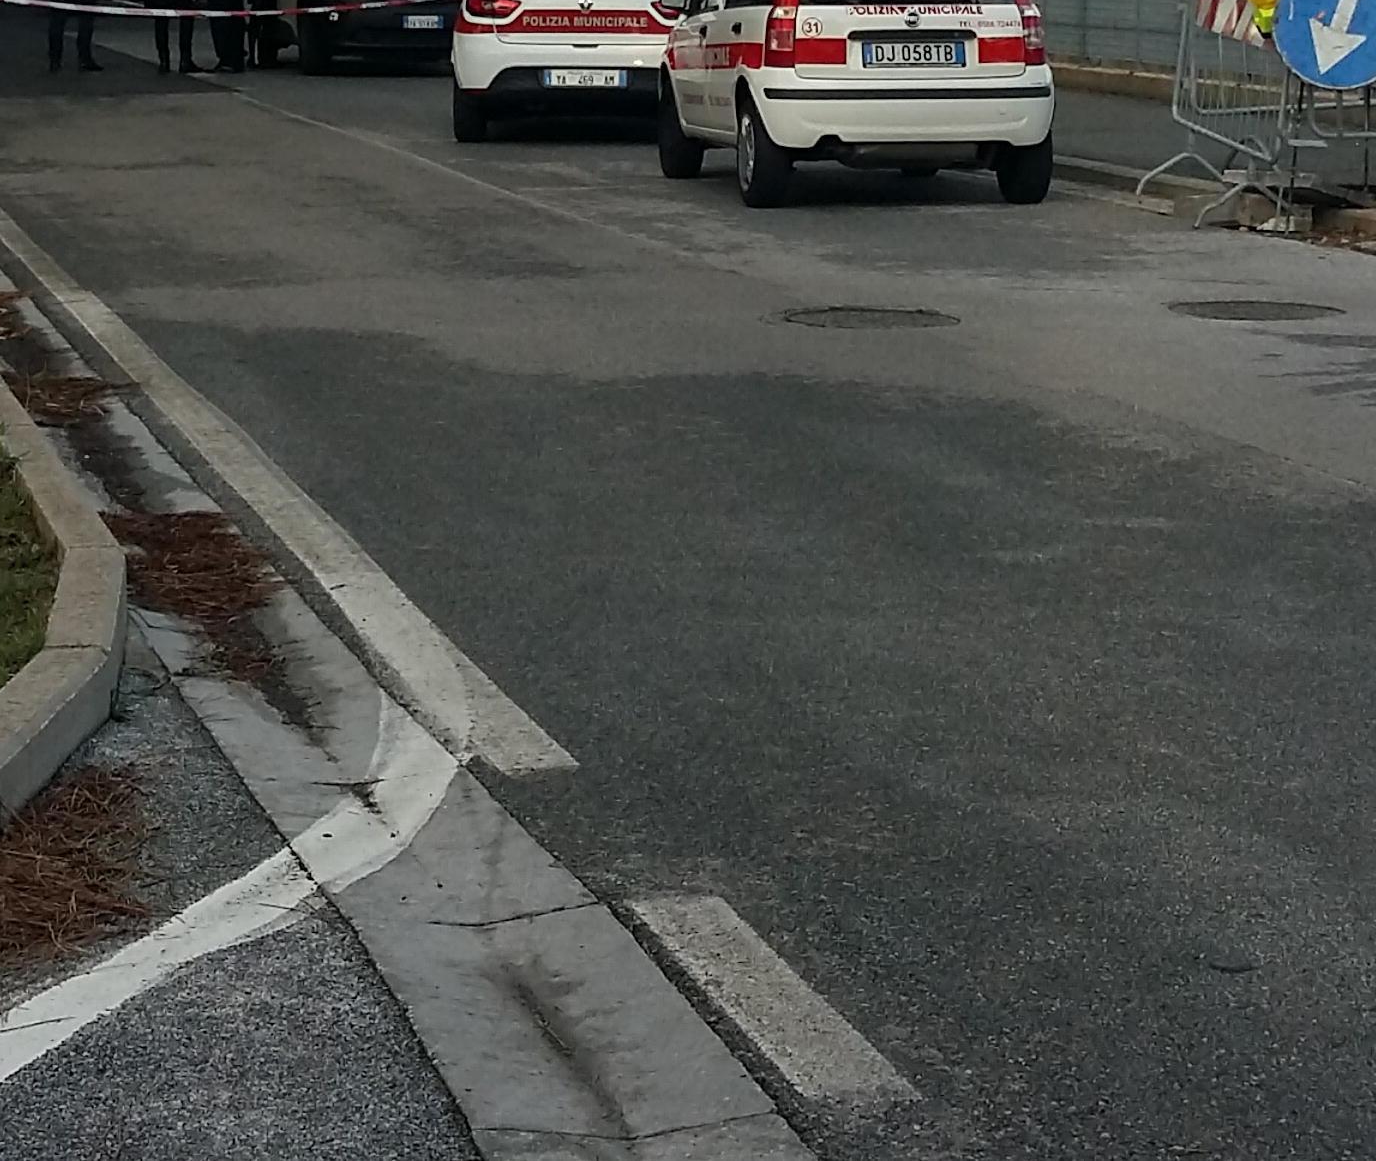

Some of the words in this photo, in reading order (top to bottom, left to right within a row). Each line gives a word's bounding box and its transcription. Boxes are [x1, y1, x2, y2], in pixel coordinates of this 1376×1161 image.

[907, 5, 983, 15] UNICIPALE
[523, 16, 571, 27] POLIZIA
[574, 16, 648, 28] MUNICIPALE
[806, 22, 819, 33] 31
